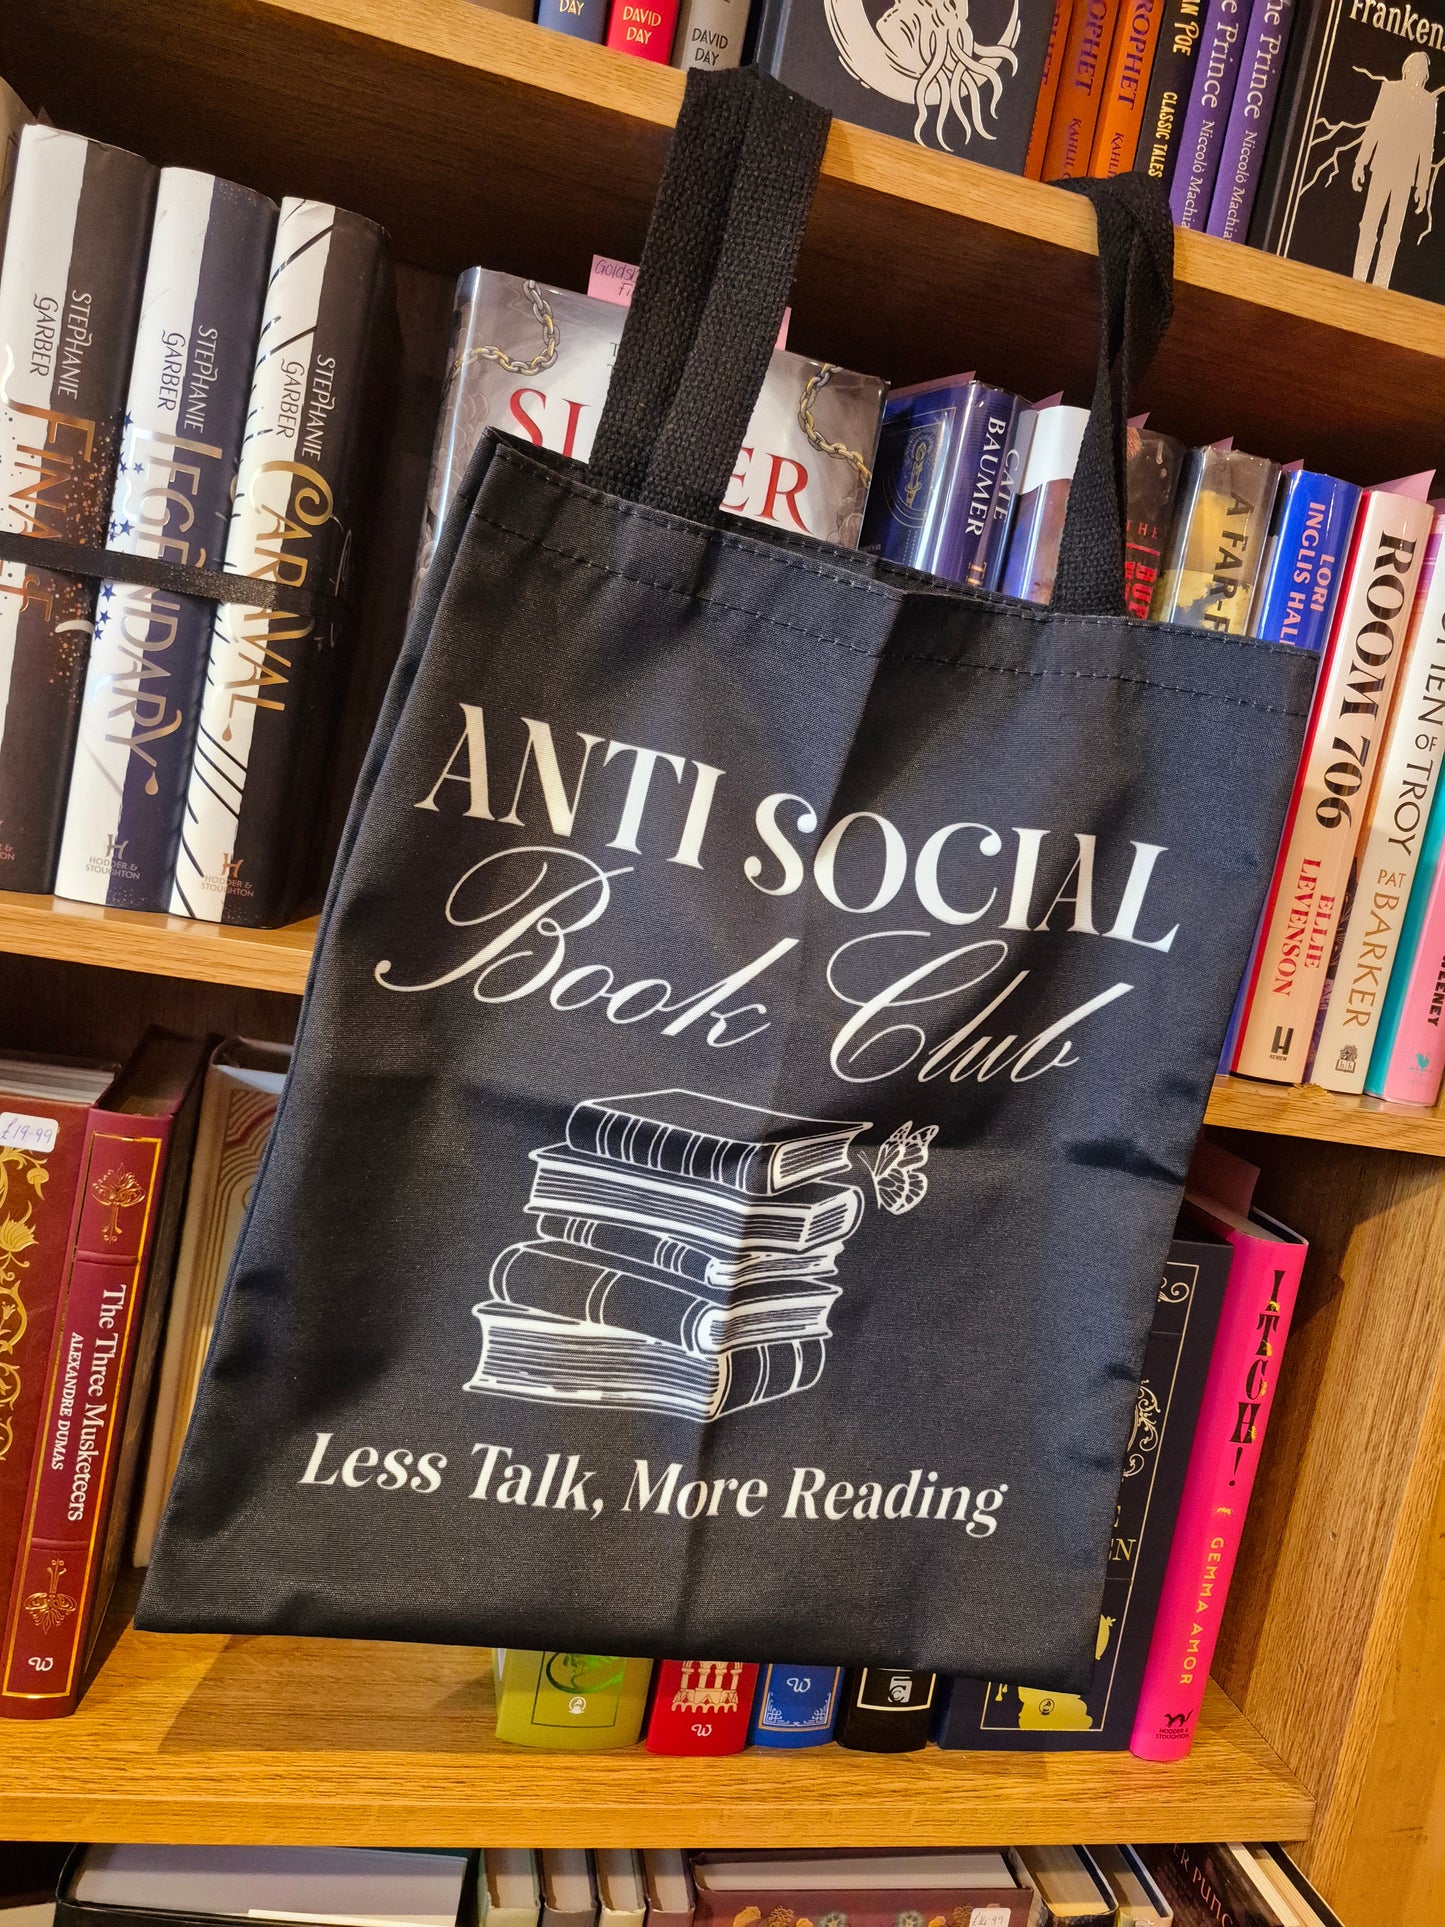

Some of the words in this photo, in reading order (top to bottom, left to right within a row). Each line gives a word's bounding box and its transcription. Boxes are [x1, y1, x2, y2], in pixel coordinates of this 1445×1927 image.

[623, 6, 662, 27] DAVID
[627, 27, 652, 45] DAY
[692, 28, 729, 49] DAVID
[1172, 21, 1200, 57] POE
[1349, 0, 1445, 53] Franken
[694, 48, 719, 66] DAY
[1201, 22, 1239, 109] Prince
[1244, 33, 1282, 120] Prince
[1063, 117, 1082, 169] KAHLIL
[1155, 91, 1178, 140] CLASSIC
[1192, 119, 1215, 174] Niccolò
[1147, 144, 1168, 178] TALES
[1235, 130, 1257, 184] Niccolò
[30, 293, 59, 377] GARBER
[57, 290, 93, 400] STEPHANIE
[158, 329, 186, 411] GARBER
[184, 326, 218, 434] STEPHANIE
[276, 358, 305, 439] GARBER
[301, 354, 336, 462] STEPHANIE
[965, 416, 1007, 536] BAUMER
[993, 448, 1021, 524] CATE
[1225, 491, 1254, 516] A
[1293, 502, 1326, 585] INGLIS
[1310, 553, 1335, 612] LORI
[1340, 530, 1417, 722] ROOM
[1415, 734, 1438, 752] OF
[1316, 734, 1372, 829] 706
[1388, 760, 1434, 857] TROY
[414, 703, 726, 869] ANTI
[744, 793, 1180, 953] SOCIAL
[85, 863, 141, 880] STOUGHTON
[89, 856, 124, 871] HODDER
[129, 862, 138, 872] &
[201, 882, 255, 897] STOUGHTON
[204, 874, 243, 890] HODDER
[244, 880, 253, 889] &
[1377, 869, 1407, 889] PAT
[1272, 858, 1321, 997] LEVENSON
[1304, 894, 1336, 970] ELLIE
[1342, 891, 1400, 1027] BARKER
[374, 846, 799, 1048] Book
[826, 930, 1134, 1083] Club
[99, 1284, 127, 1329] The
[60, 1332, 85, 1417] ALEXANDRE
[88, 1333, 119, 1397] Three
[1229, 1270, 1287, 1487] ITCH!
[51, 1419, 71, 1471] DUMAS
[67, 1403, 108, 1521] Musketeers
[299, 1433, 448, 1493] Less
[469, 1443, 604, 1521] Talk,
[622, 1459, 768, 1519] More
[781, 1467, 1008, 1538] Reading
[1196, 1537, 1224, 1613] GEMMA
[1180, 1622, 1204, 1686] AMOR
[1155, 1732, 1190, 1740] STOUGHTON
[1159, 1727, 1183, 1735] HODDER
